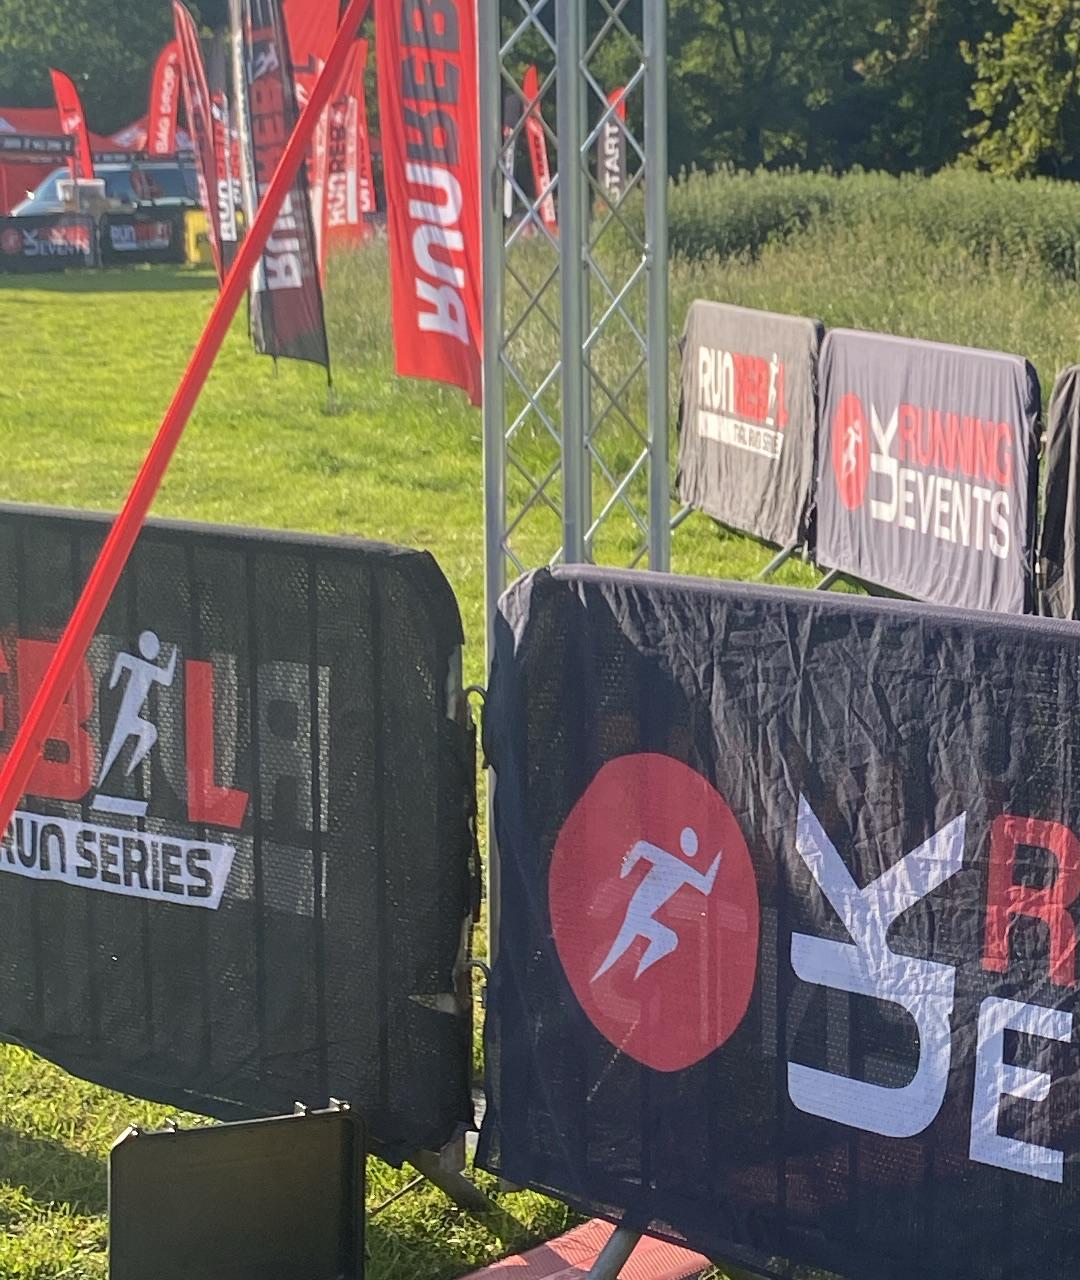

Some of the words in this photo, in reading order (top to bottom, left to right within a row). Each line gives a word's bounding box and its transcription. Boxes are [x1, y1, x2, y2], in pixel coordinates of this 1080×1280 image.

[899, 402, 1014, 488] RUNNING
[898, 467, 1010, 560] EVENTS
[75, 829, 214, 899] SERIES
